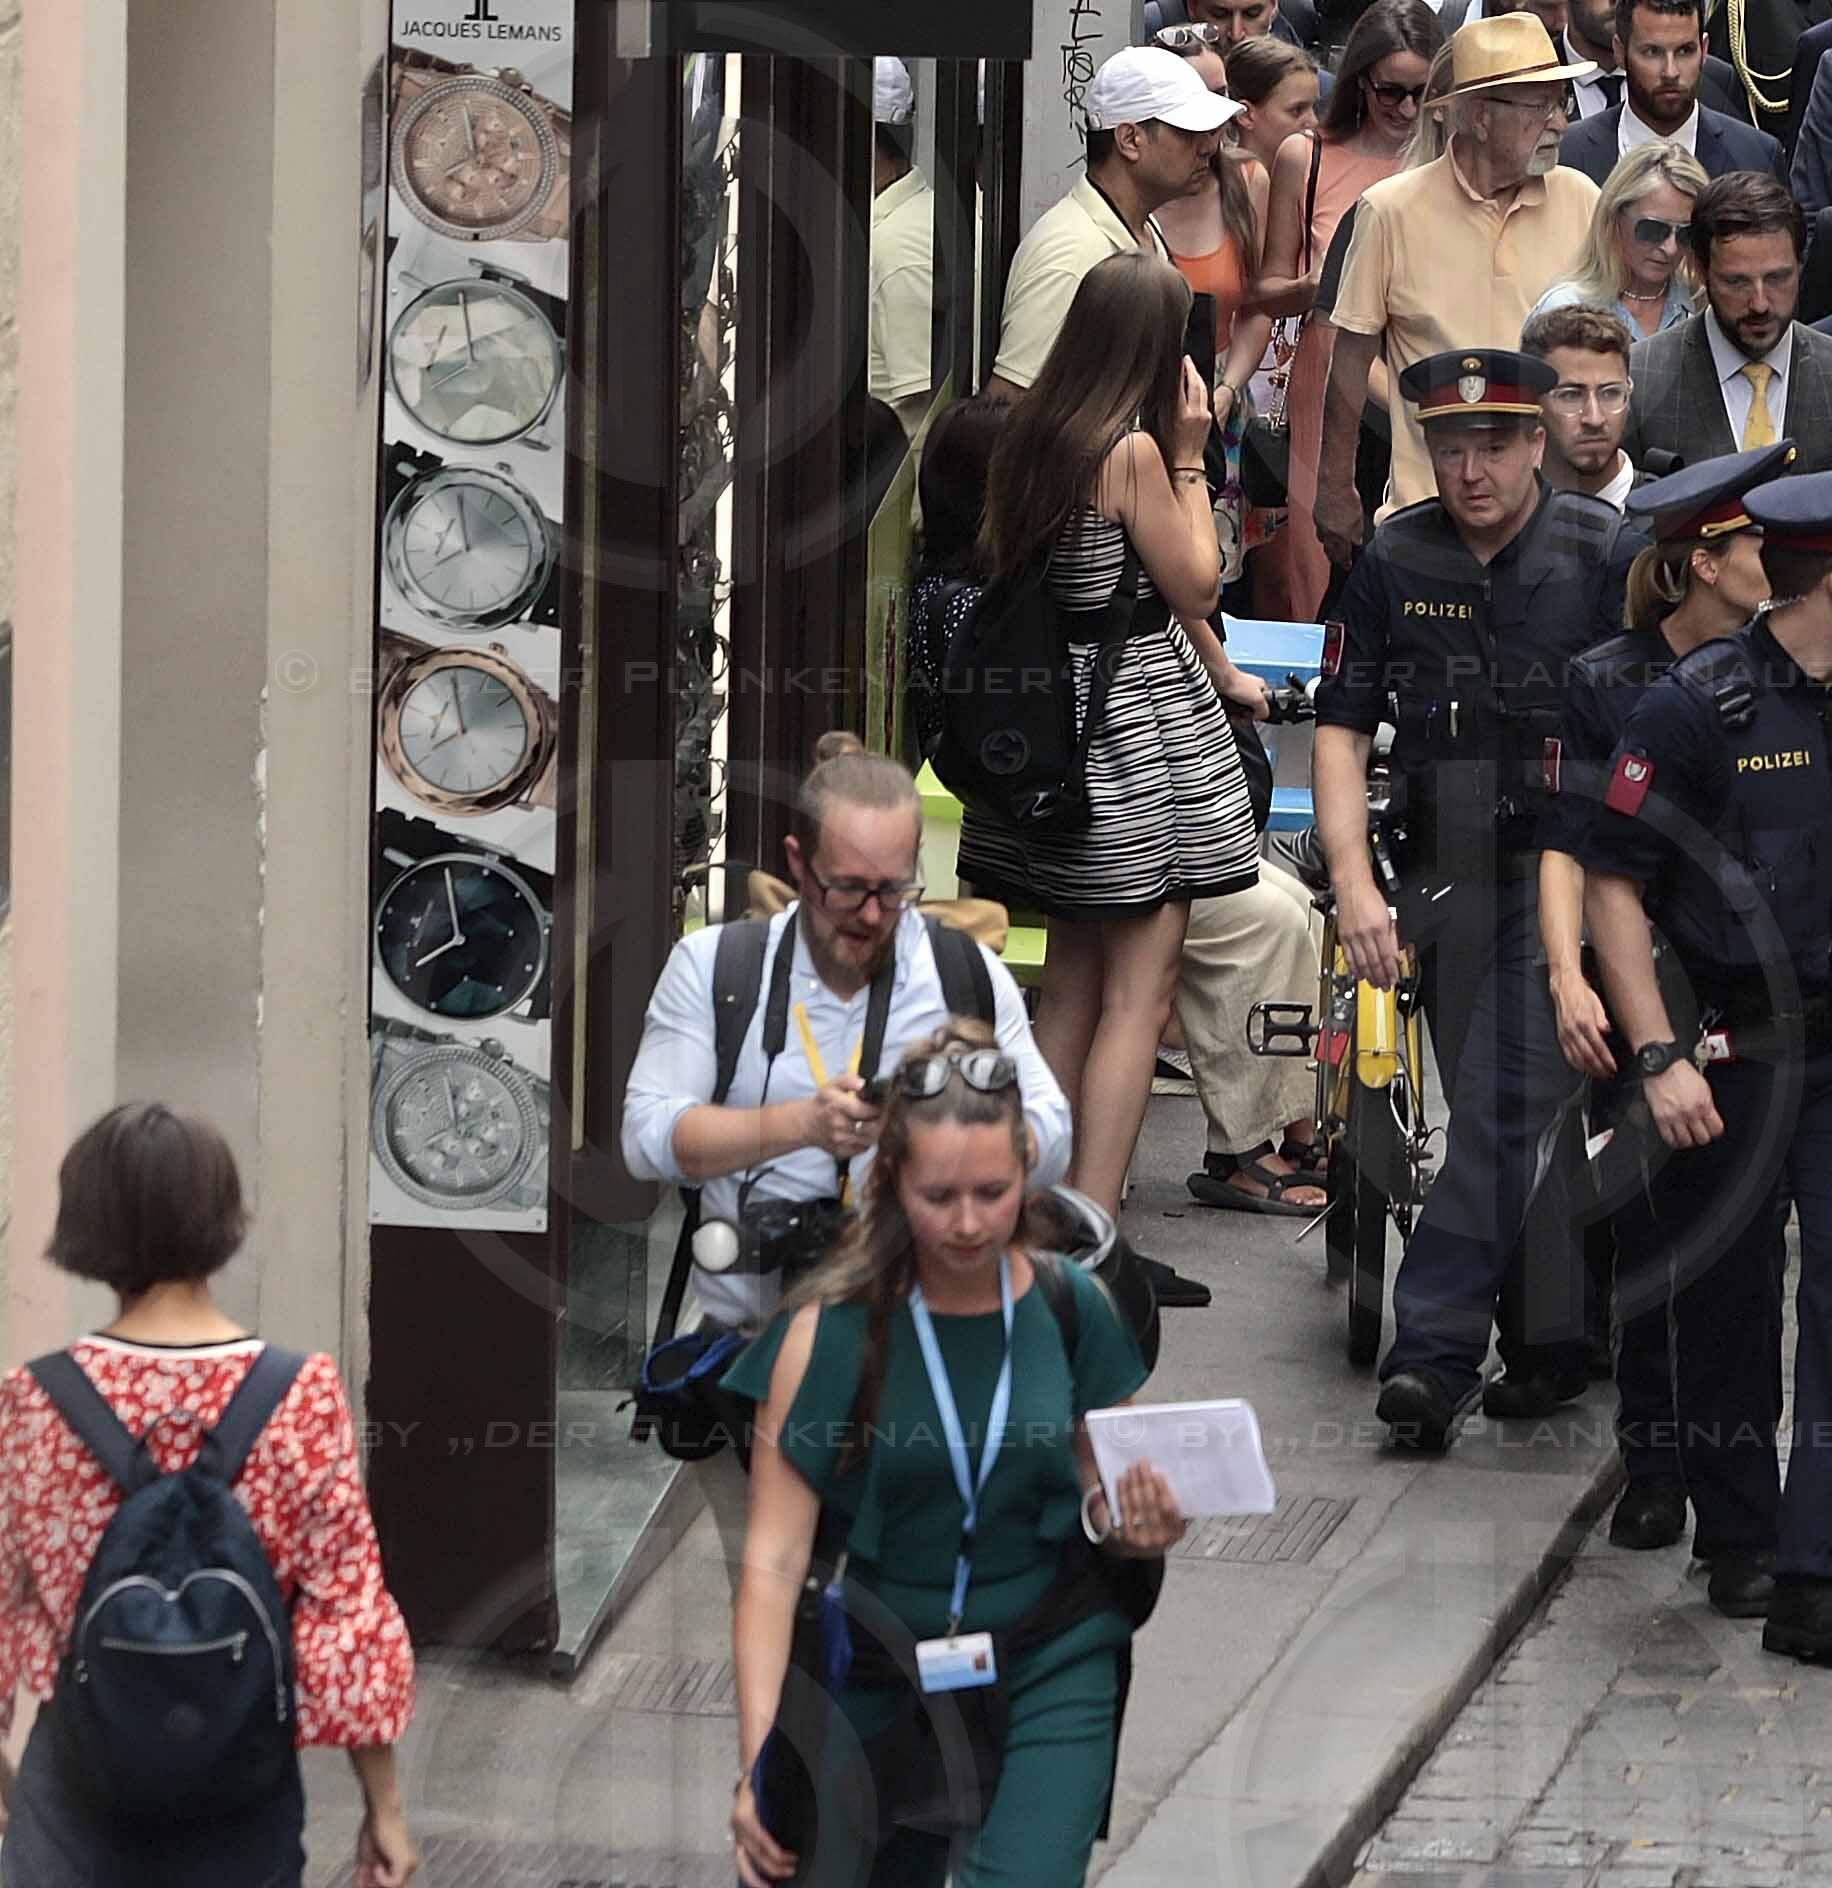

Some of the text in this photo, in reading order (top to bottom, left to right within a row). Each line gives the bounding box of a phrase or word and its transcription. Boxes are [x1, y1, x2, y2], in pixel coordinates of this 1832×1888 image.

[401, 21, 562, 42] JACQUES LEMANS
[1403, 600, 1474, 620] POLIZEI
[1736, 749, 1811, 772] POLIZEI
